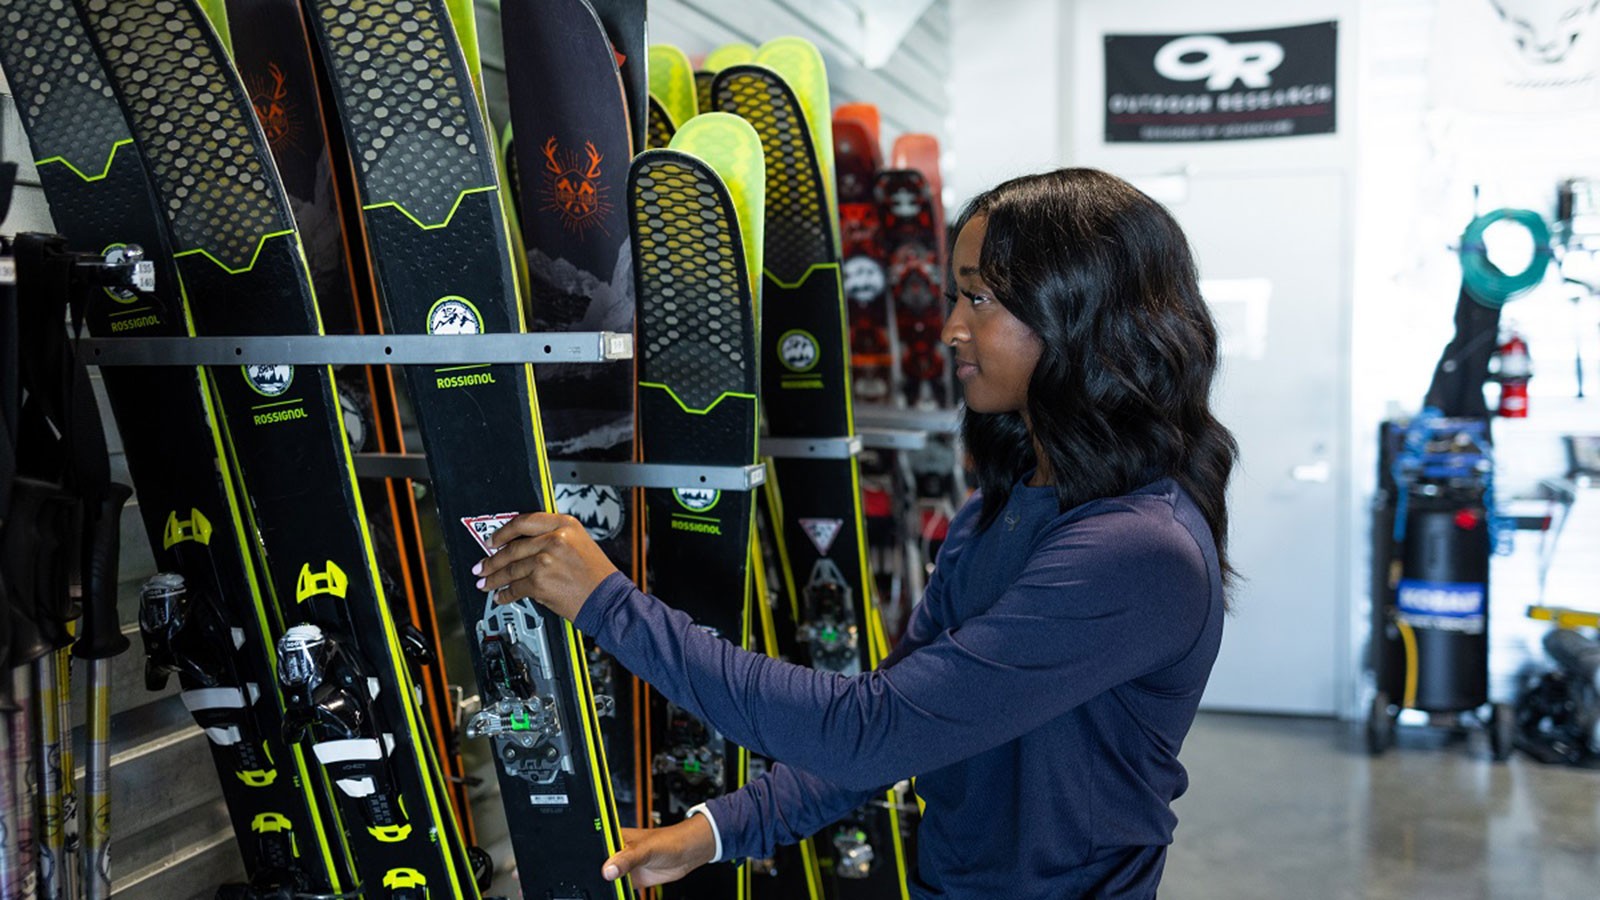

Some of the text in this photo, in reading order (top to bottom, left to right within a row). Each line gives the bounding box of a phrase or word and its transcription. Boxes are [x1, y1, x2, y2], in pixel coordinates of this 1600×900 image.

[1154, 35, 1285, 90] OR
[1109, 84, 1332, 114] OUTDOOR RESEARCH
[111, 315, 161, 332] ROSSIGNOL
[437, 372, 496, 389] ROSSIGNOL
[253, 407, 308, 425] ROSSIGNOL
[671, 519, 722, 535] ROSSIGNOL
